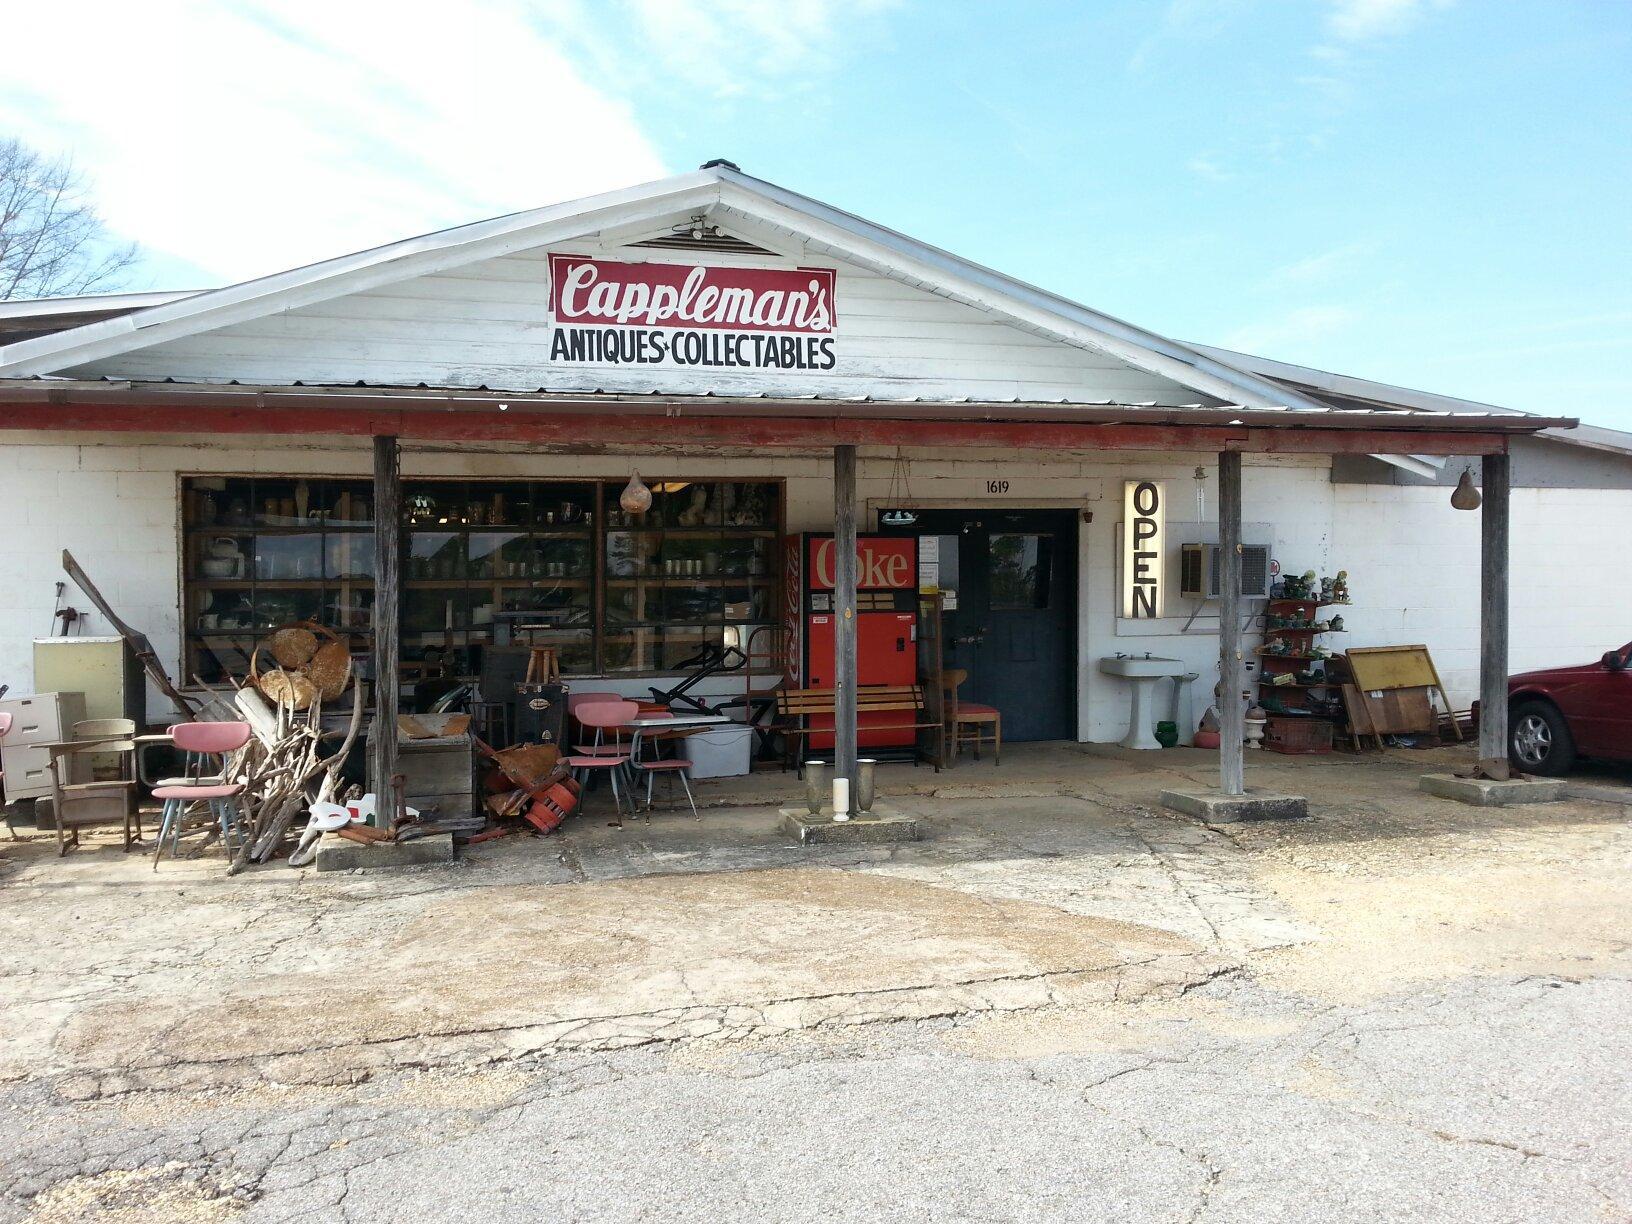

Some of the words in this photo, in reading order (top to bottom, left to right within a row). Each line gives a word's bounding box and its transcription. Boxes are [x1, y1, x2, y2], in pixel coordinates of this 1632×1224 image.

[561, 263, 831, 332] Cappleman's
[550, 328, 665, 365] ANTIQUES
[671, 331, 836, 370] COLLECTABLES
[986, 480, 1009, 493] 1619
[1132, 482, 1159, 618] OPEN
